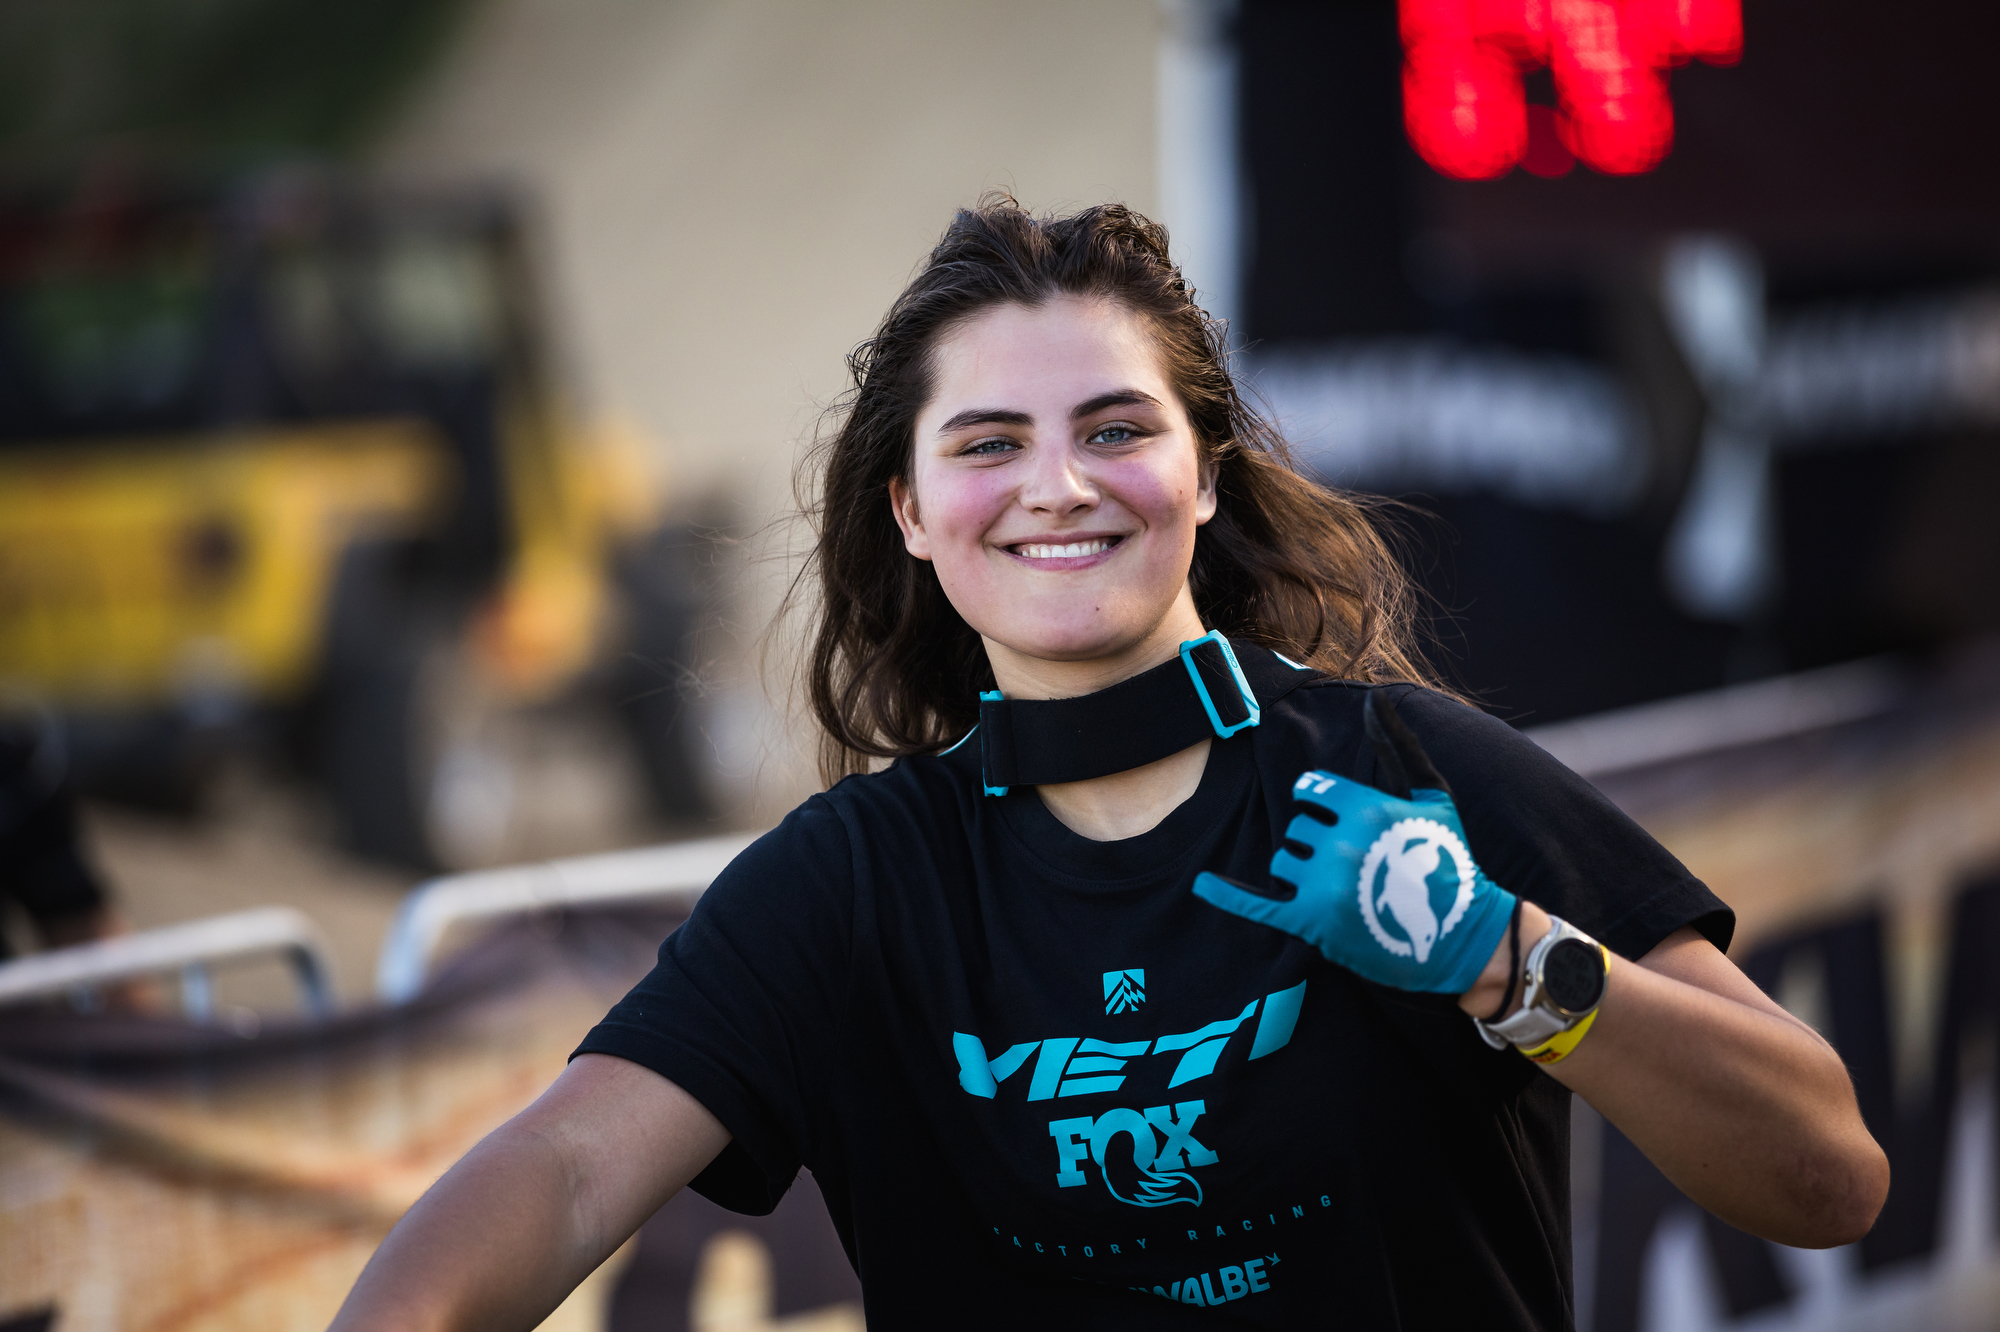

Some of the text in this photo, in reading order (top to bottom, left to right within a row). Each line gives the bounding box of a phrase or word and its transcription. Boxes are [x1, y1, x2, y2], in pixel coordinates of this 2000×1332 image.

[1294, 770, 1337, 795] TI
[952, 979, 1307, 1102] YETI
[1048, 1099, 1220, 1208] FOX
[993, 1194, 1333, 1258] FACTORY RACING
